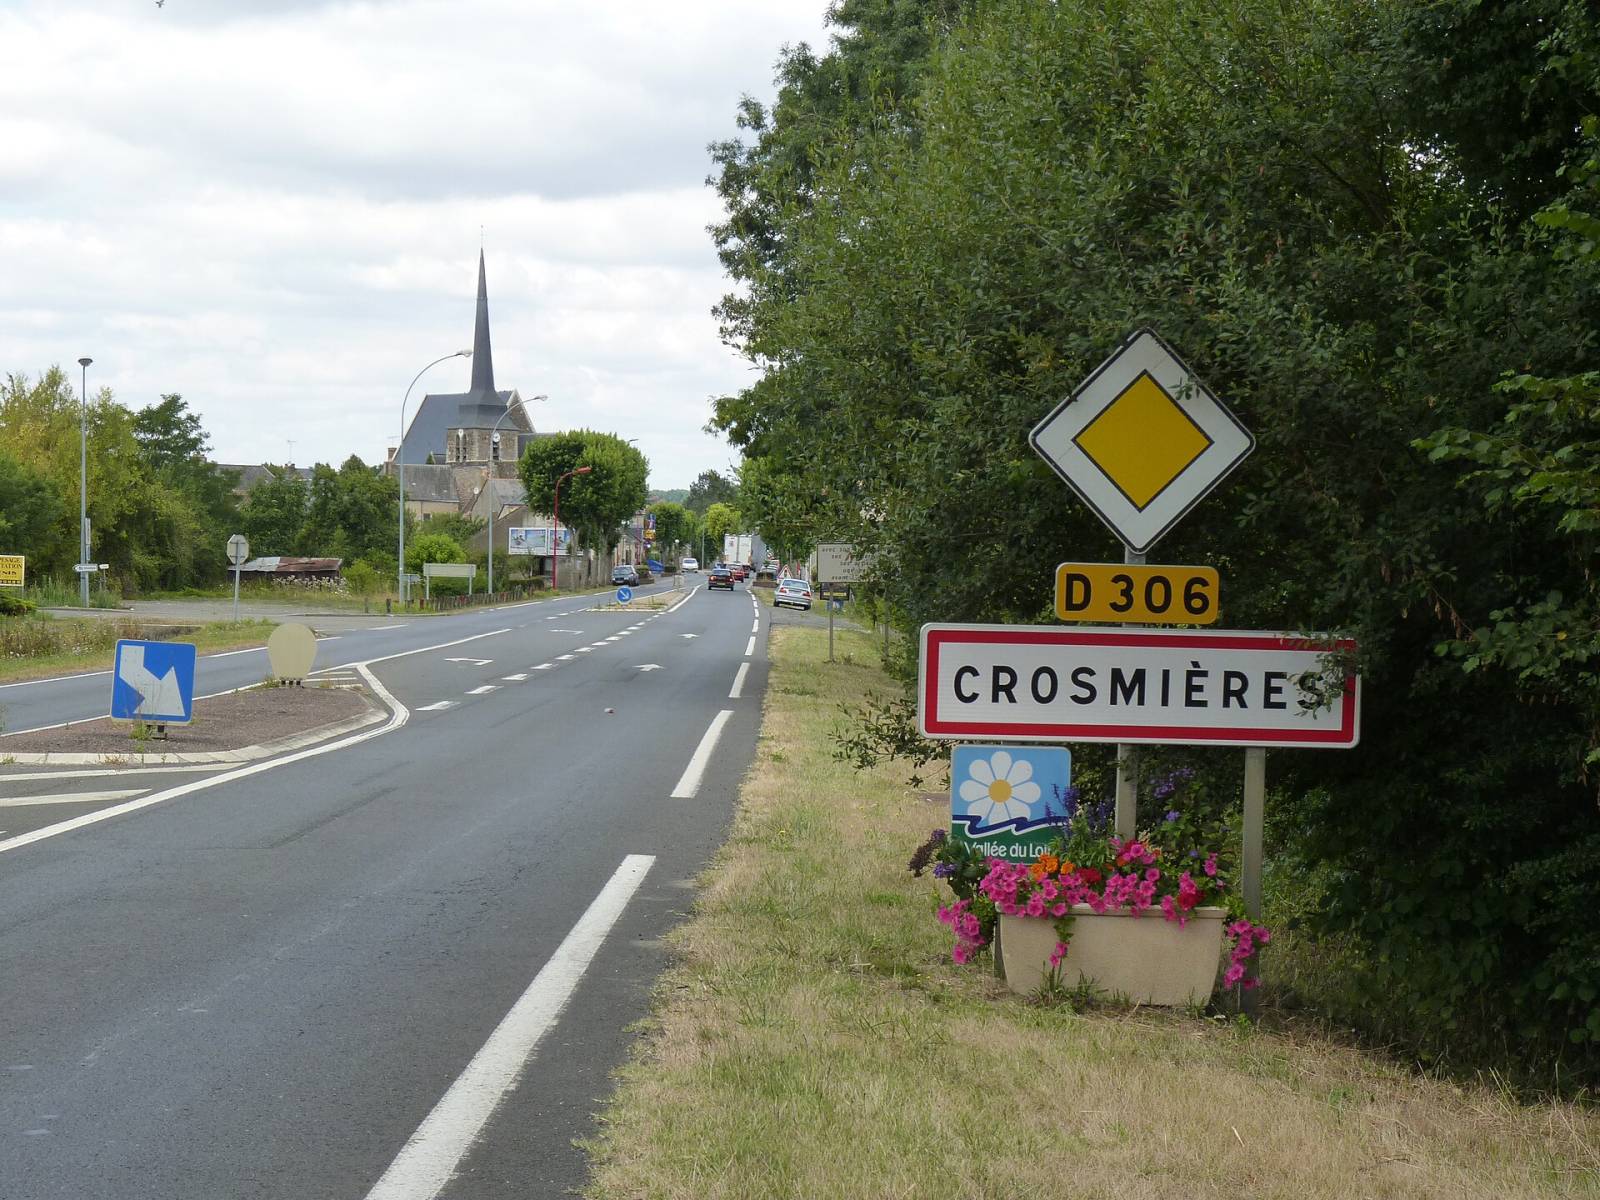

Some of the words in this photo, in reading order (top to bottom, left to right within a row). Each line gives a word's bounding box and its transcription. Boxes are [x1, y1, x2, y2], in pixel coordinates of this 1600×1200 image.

[1065, 573, 1091, 611] D
[1109, 573, 1210, 615] 306
[953, 660, 1324, 711] CROSMIÈRES
[1009, 843, 1027, 858] du
